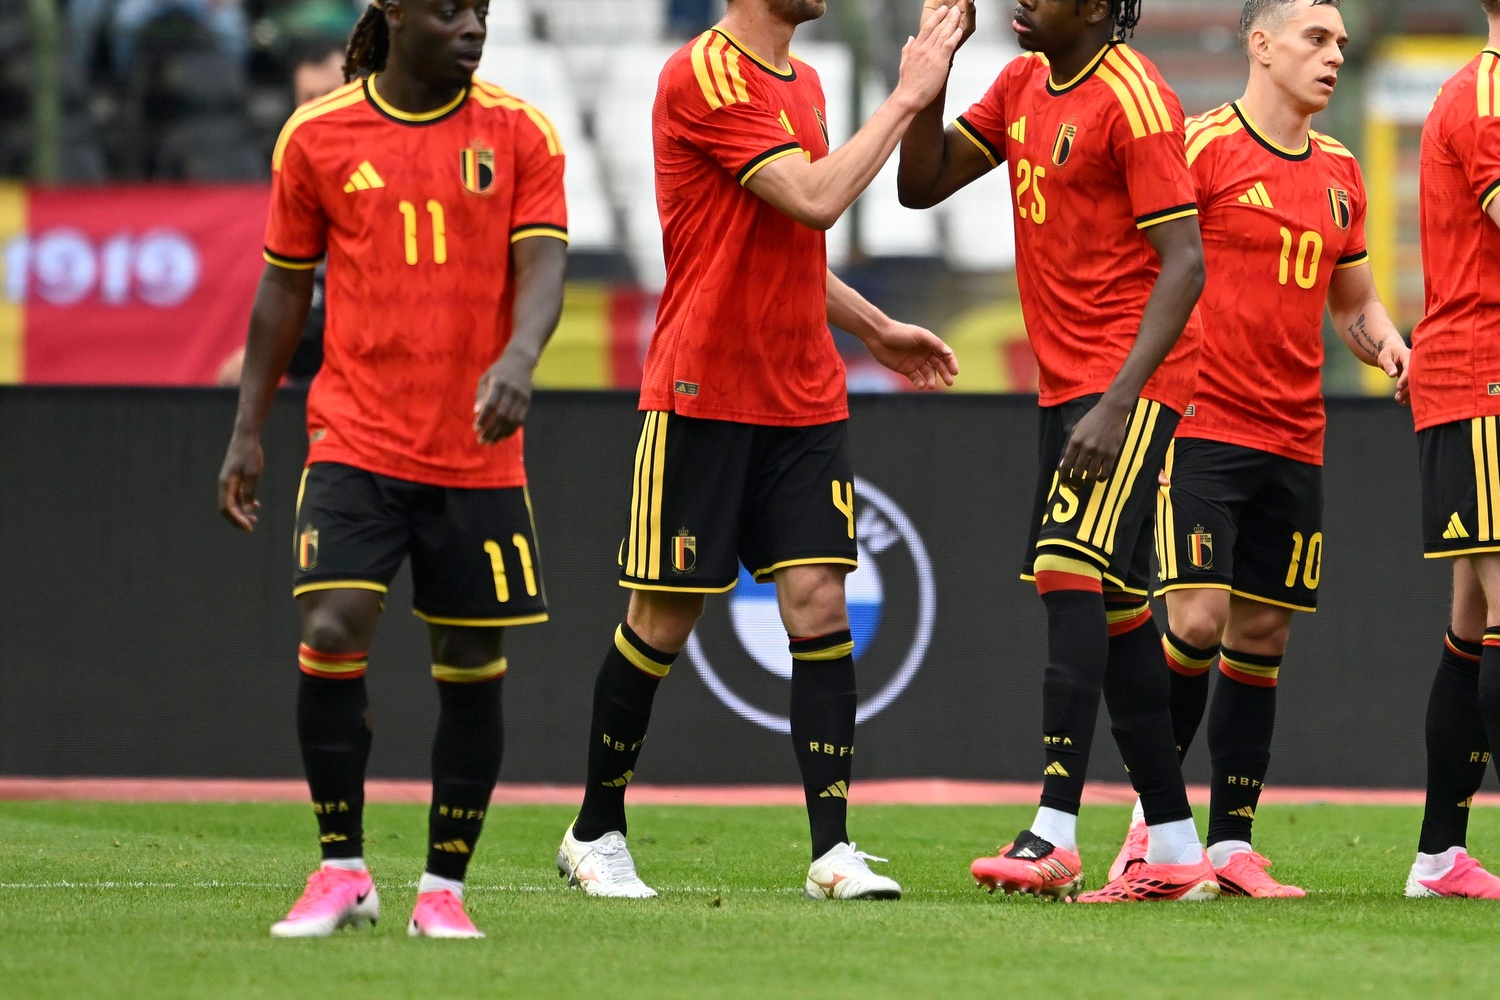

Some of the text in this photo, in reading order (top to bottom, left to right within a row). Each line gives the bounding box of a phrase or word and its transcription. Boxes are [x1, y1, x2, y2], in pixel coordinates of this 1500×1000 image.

[1016, 158, 1046, 225] 25
[398, 199, 447, 266] 11
[1278, 226, 1323, 290] 10
[832, 479, 855, 540] 4
[483, 533, 538, 603] 11
[1285, 531, 1323, 590] 10
[603, 733, 647, 752] RBF
